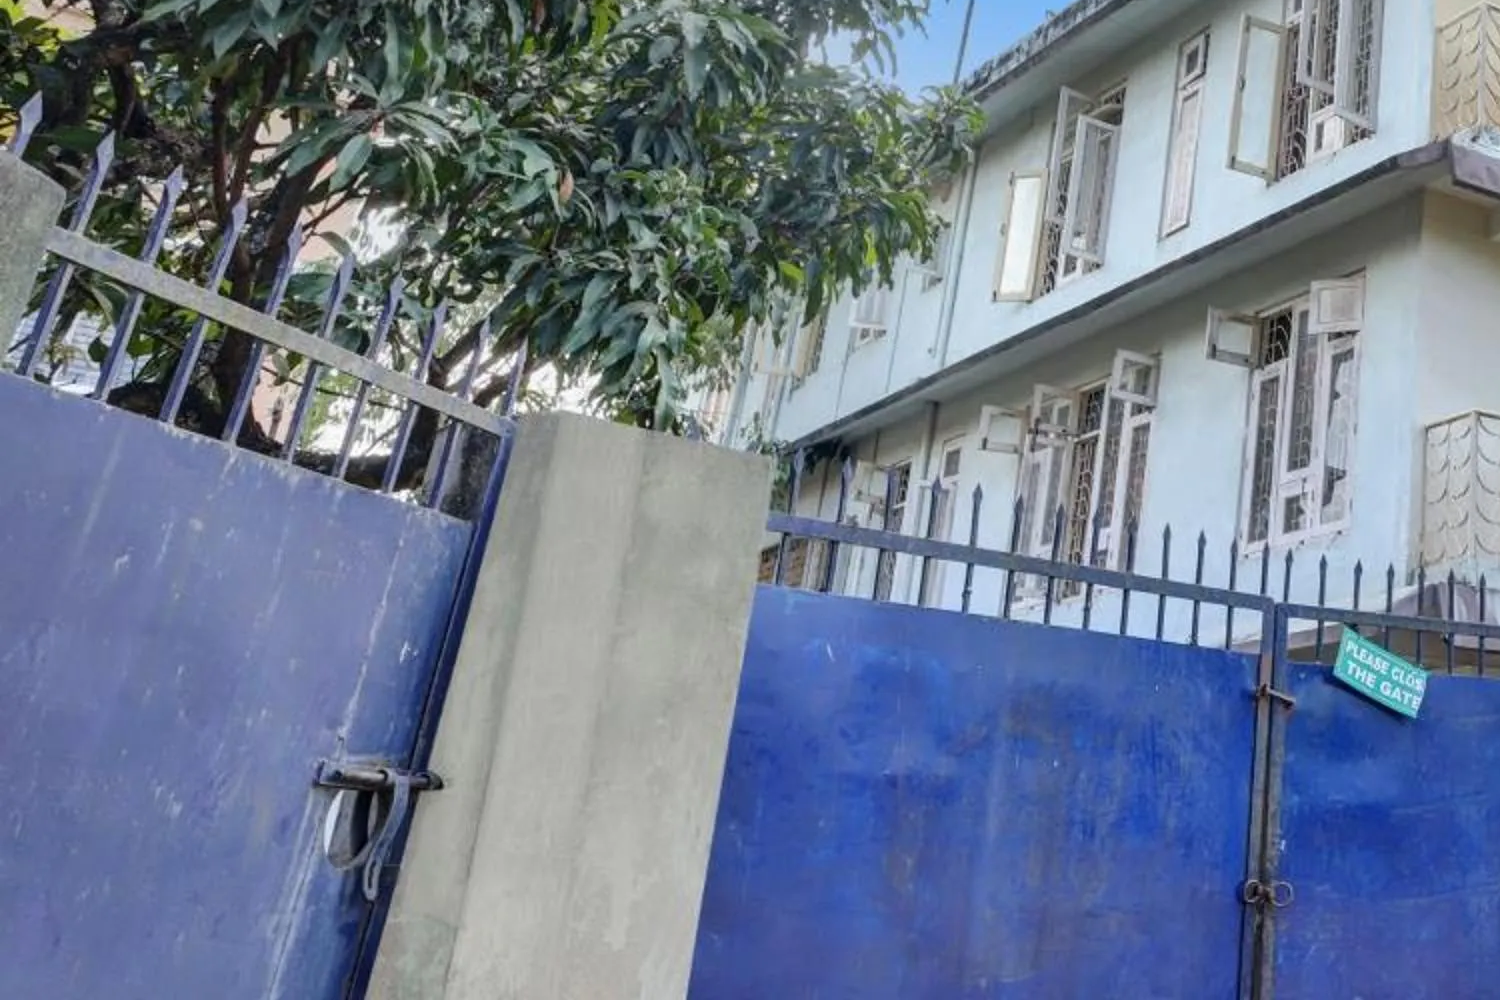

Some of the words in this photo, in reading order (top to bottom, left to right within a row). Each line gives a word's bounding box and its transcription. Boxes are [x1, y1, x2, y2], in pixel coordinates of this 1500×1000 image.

[1345, 640, 1390, 675] PLEASE
[1346, 660, 1377, 689] THE
[1380, 681, 1423, 712] GATE
